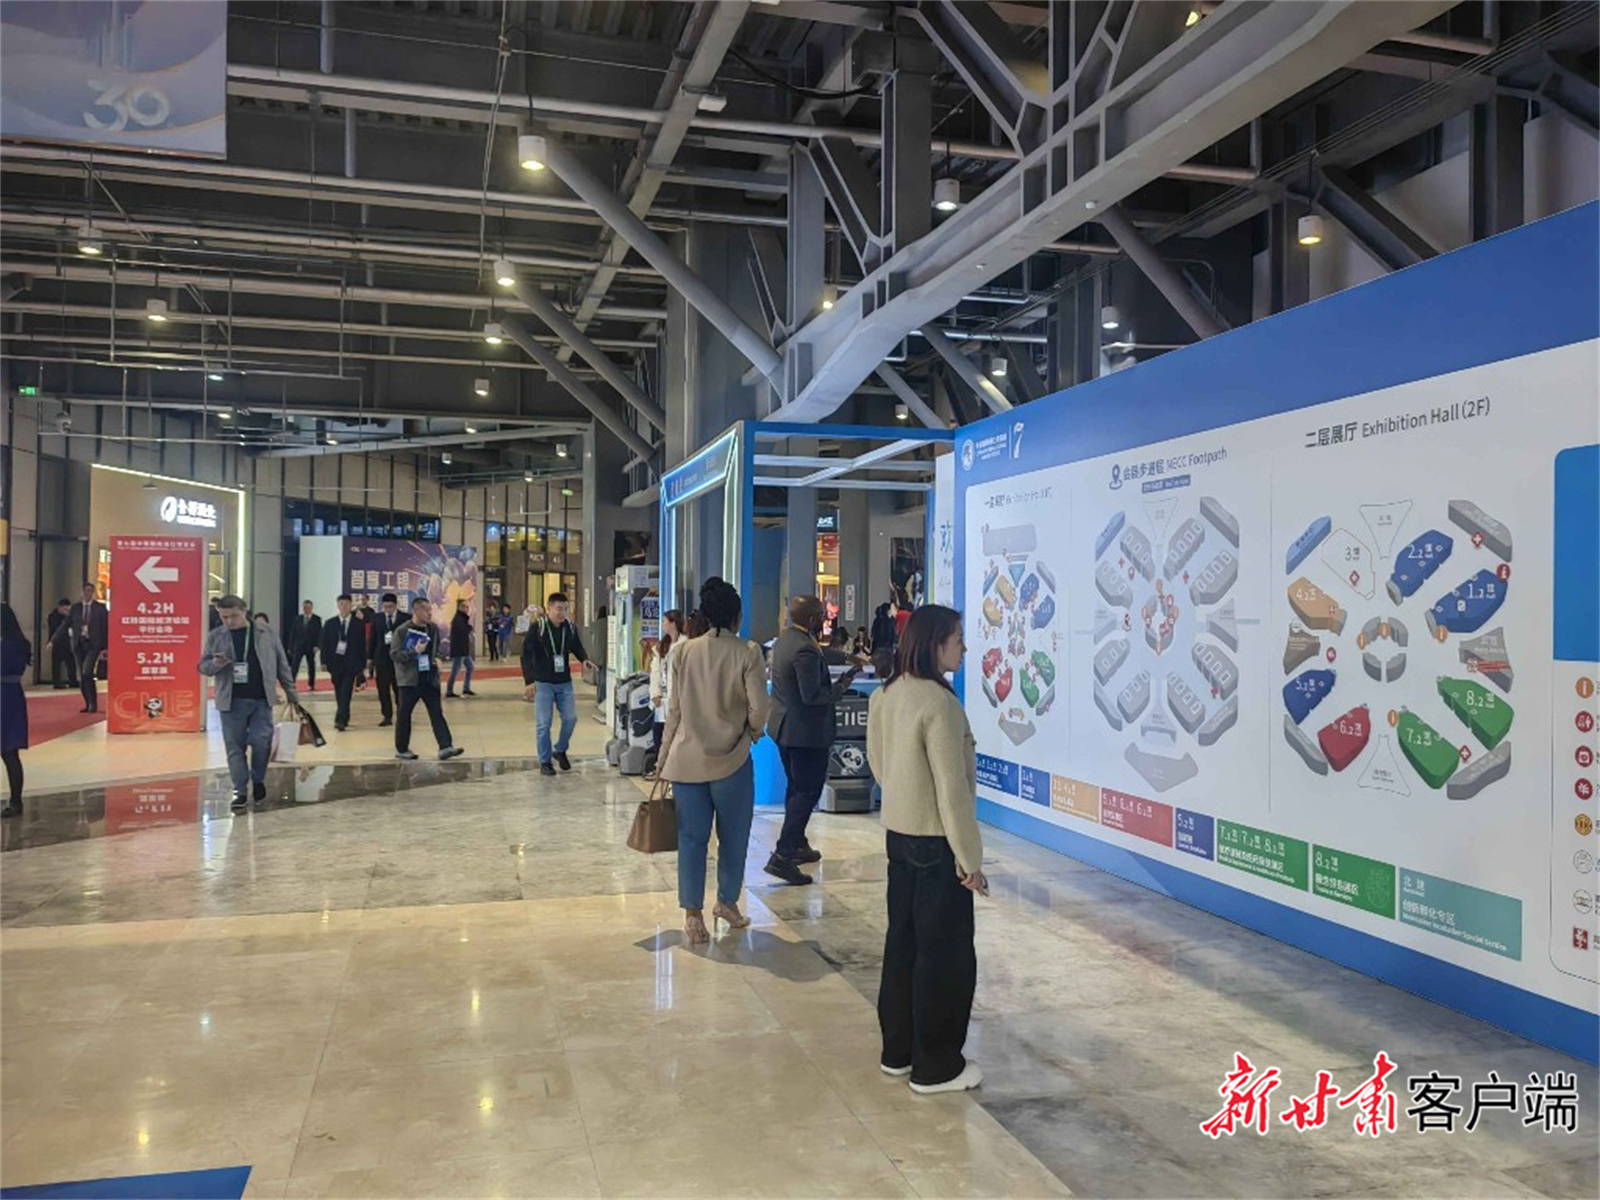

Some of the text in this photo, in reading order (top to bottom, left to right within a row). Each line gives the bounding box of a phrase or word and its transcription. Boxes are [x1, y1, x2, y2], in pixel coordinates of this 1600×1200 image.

[83, 79, 169, 131] 30
[1305, 396, 1491, 448] 二层展厅 Exhibition Hall (2F)
[1189, 446, 1227, 466] Footpath
[137, 602, 174, 614] 4.2H
[137, 652, 174, 664] 5.2H
